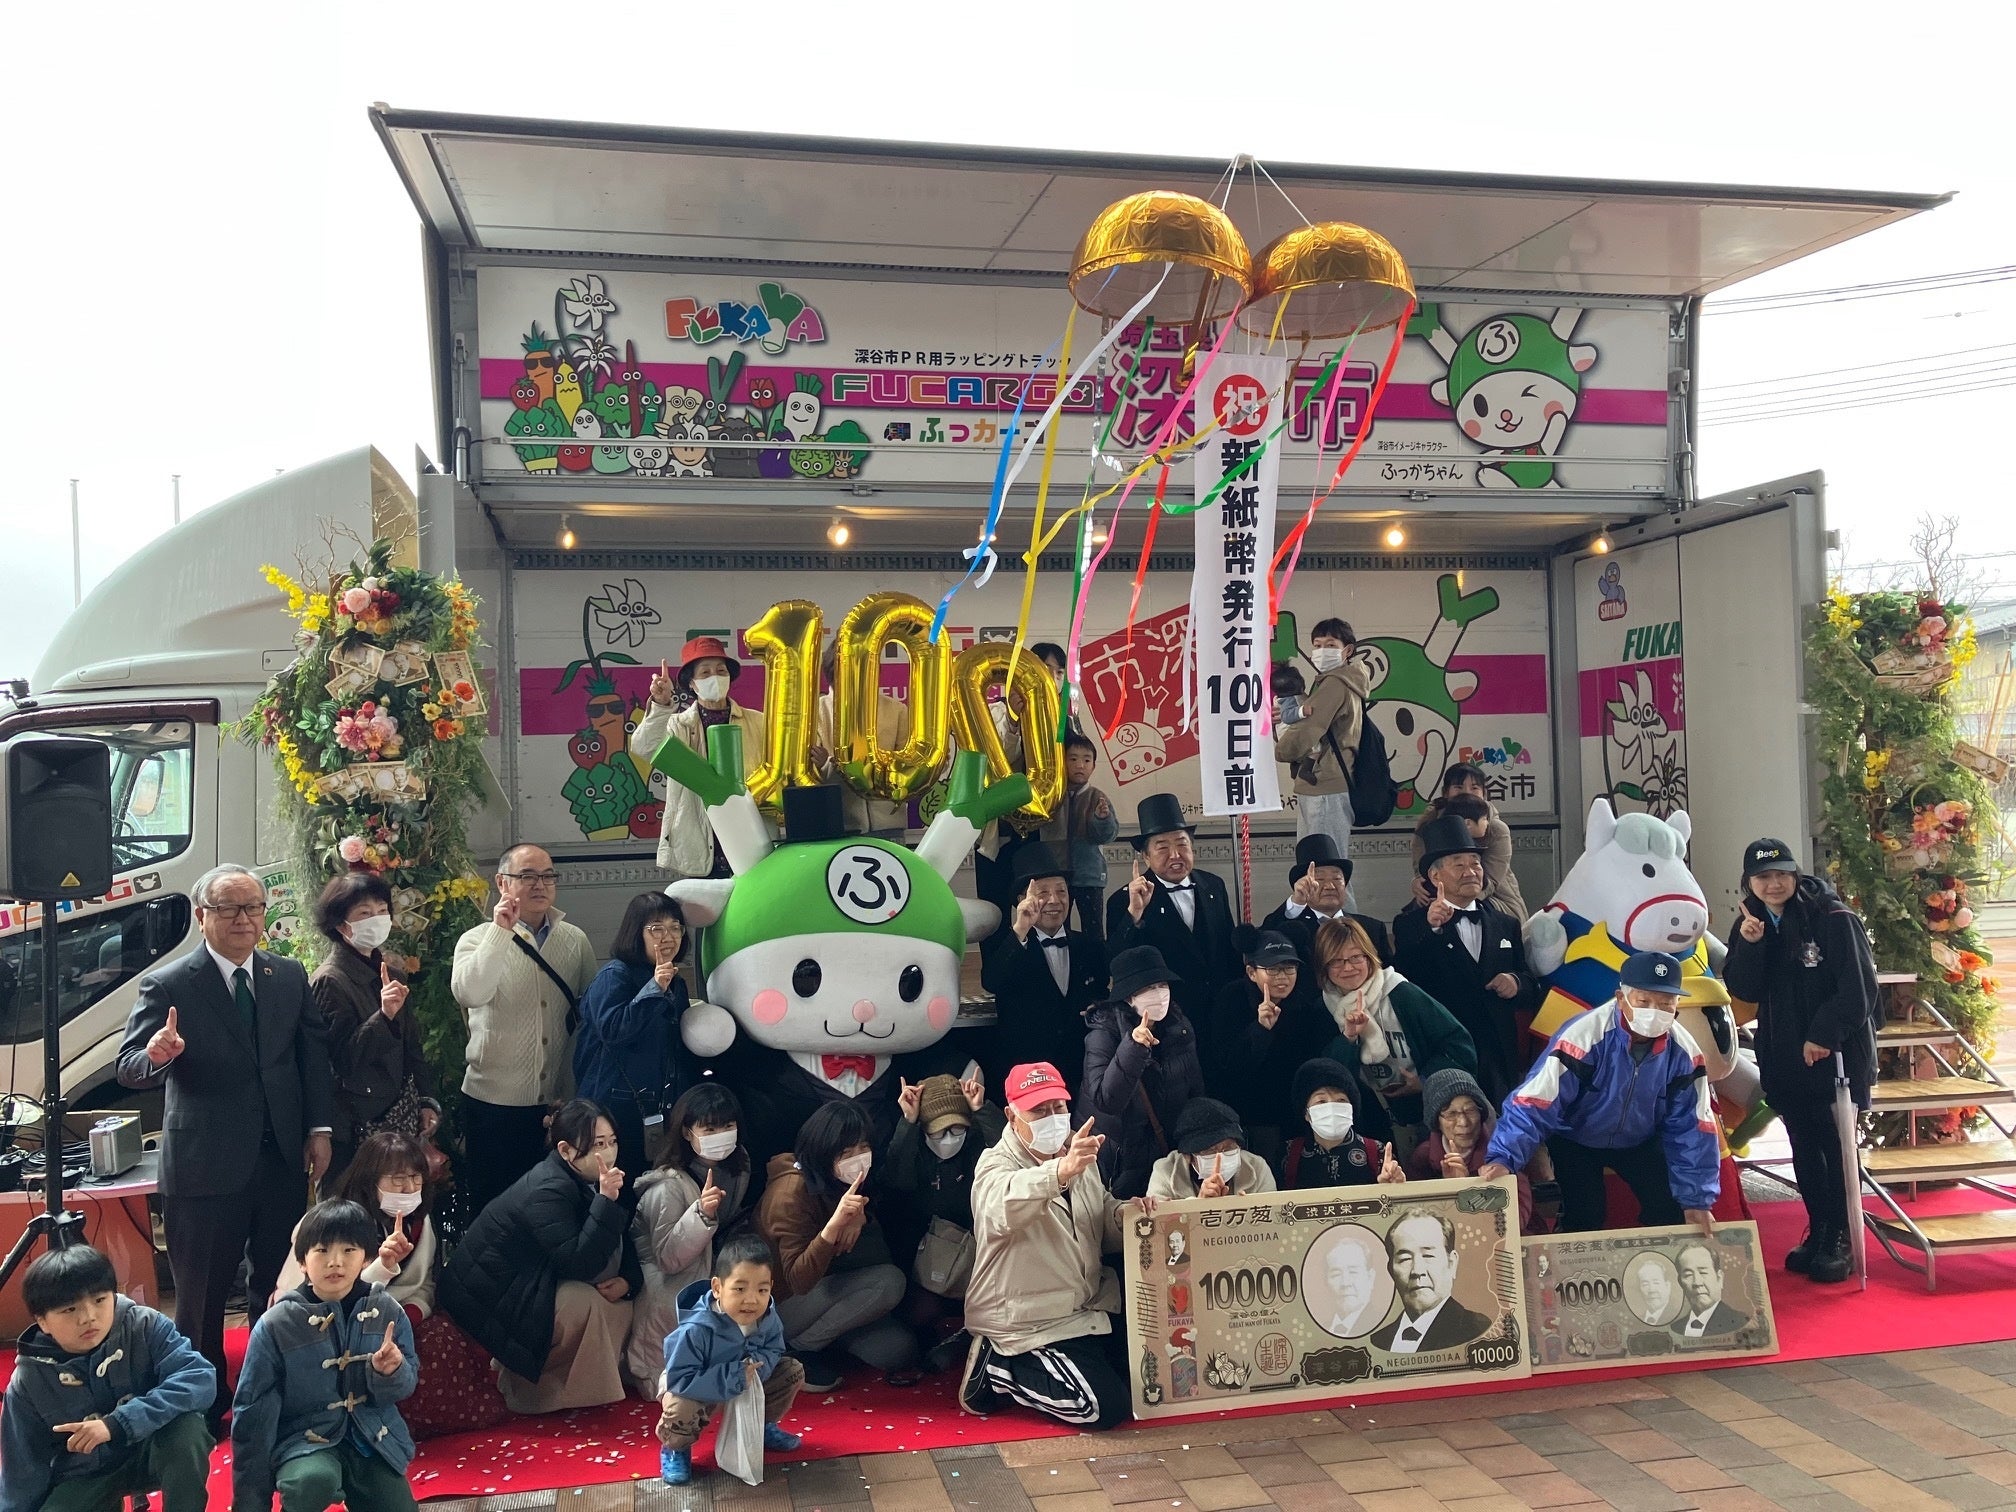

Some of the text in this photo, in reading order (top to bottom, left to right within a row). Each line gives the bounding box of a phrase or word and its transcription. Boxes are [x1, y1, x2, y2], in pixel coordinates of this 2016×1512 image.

[1480, 323, 1517, 357] ふ
[854, 348, 1072, 368] 深谷市PR用ラッピングトラッ
[1115, 355, 1374, 444] 深市
[1377, 440, 1448, 451] 深谷市イメージキャラクター
[1381, 463, 1463, 481] ふっかちゃん
[1485, 773, 1536, 801] 谷市
[837, 856, 902, 910] ふ
[1305, 1203, 1370, 1218] 渋沢栄一
[1202, 1231, 1280, 1247] NEGI000001AA
[1198, 1264, 1298, 1311] 10000
[1555, 1278, 1622, 1307] 10000
[1168, 1318, 1194, 1327] FUKAYA
[1386, 1352, 1461, 1368] NEGI000001AA
[1471, 1346, 1514, 1365] 10000
